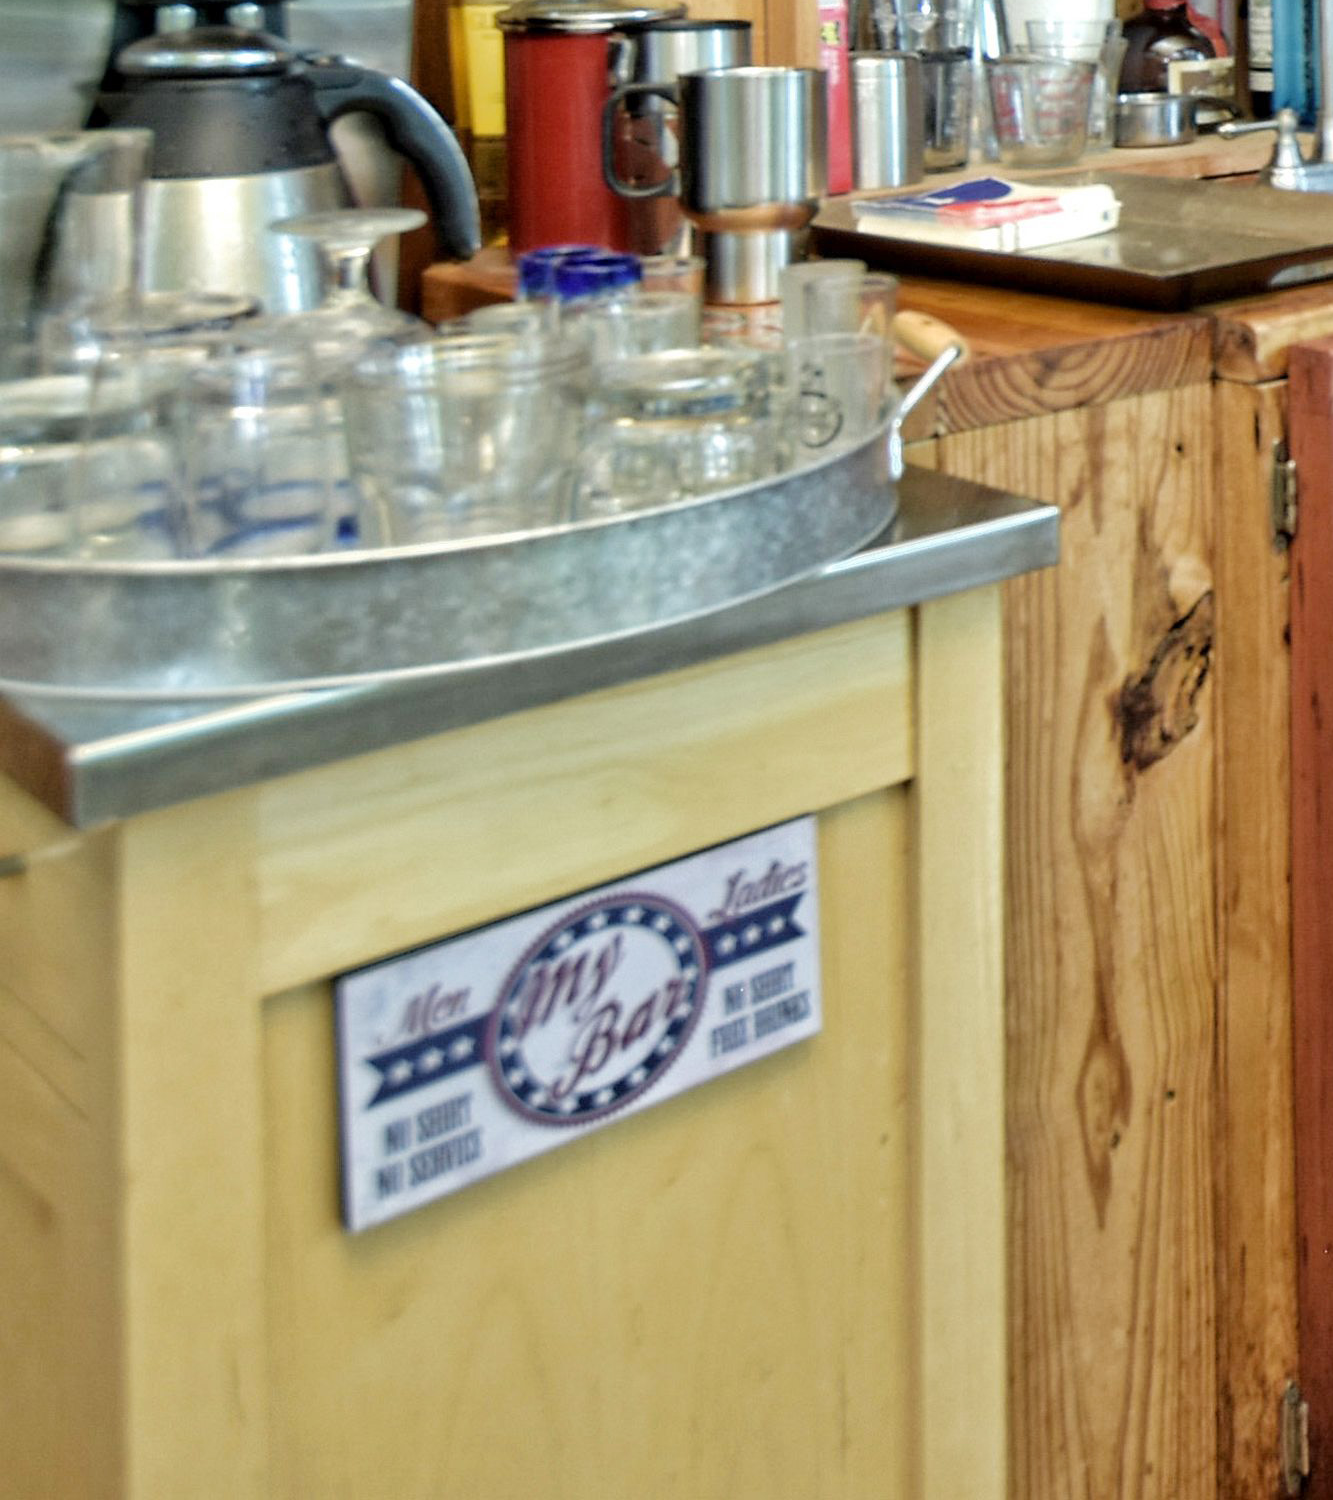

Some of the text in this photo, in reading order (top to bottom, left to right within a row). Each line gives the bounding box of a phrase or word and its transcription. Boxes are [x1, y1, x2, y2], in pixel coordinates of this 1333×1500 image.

[380, 981, 473, 1044] Men
[517, 931, 624, 1040] My
[551, 979, 684, 1099] Bar
